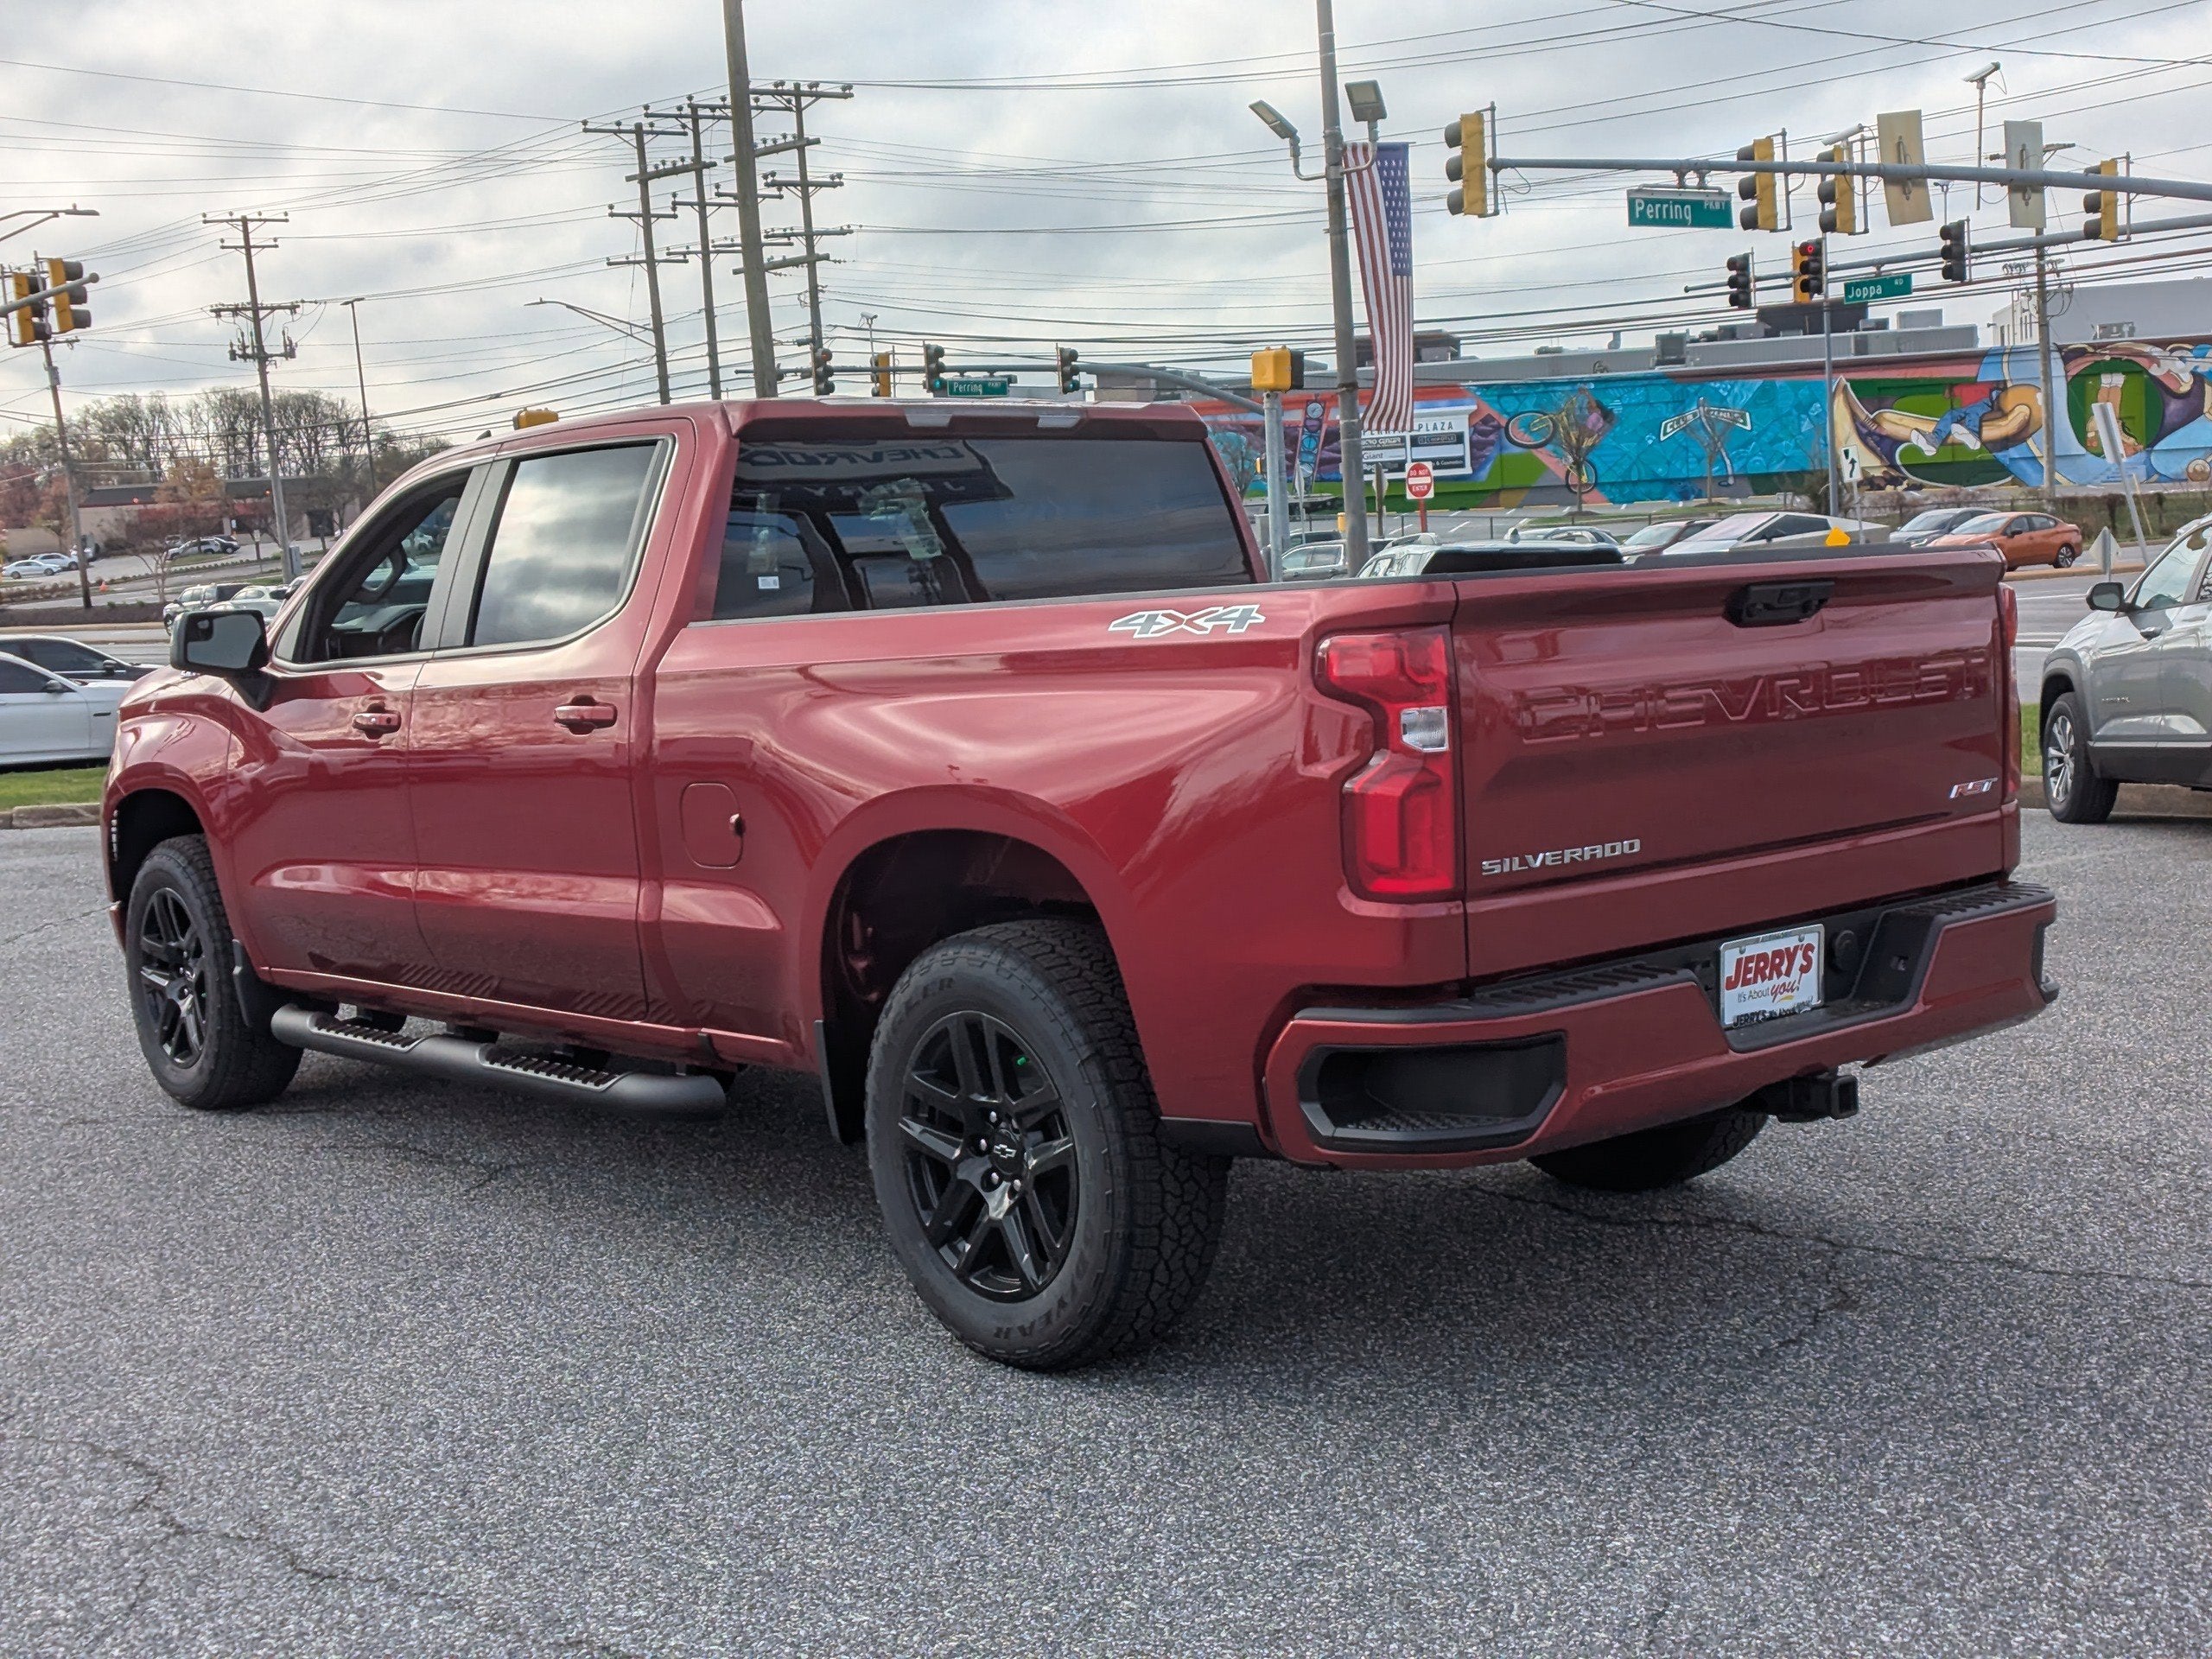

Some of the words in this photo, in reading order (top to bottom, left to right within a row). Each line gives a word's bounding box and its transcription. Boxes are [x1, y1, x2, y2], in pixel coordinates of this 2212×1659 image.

[1635, 198, 1692, 226] Perring
[1704, 200, 1726, 210] PKWY
[1848, 285, 1882, 299] Joppa
[953, 382, 982, 397] Perring
[1418, 421, 1453, 432] PLAZA
[1521, 658, 1986, 744] CHEVROLET
[1950, 778, 1998, 798] RST
[1481, 839, 1641, 875] SILVERADO
[1725, 943, 1815, 991] JERRY'S
[1748, 987, 1770, 1001] About
